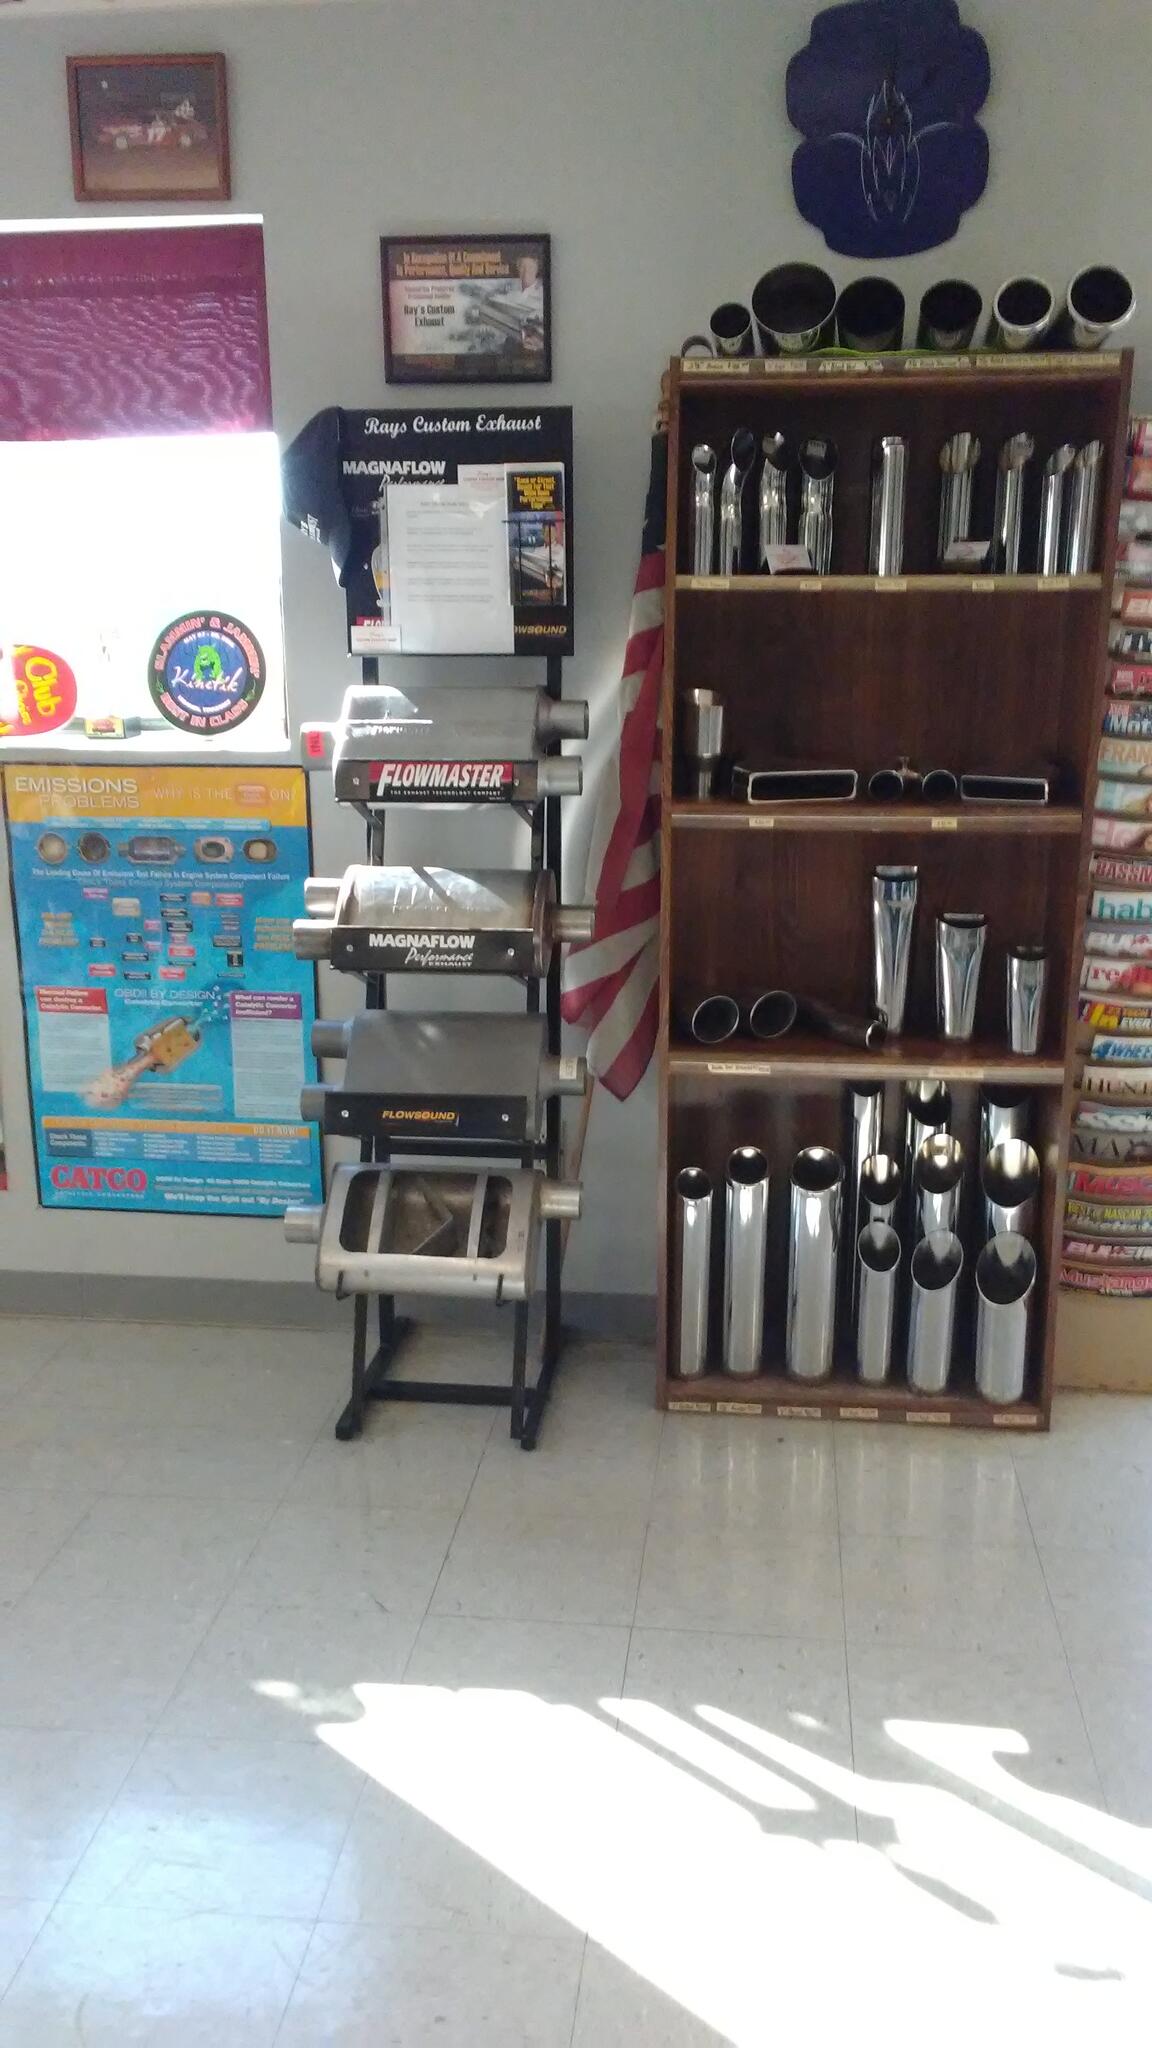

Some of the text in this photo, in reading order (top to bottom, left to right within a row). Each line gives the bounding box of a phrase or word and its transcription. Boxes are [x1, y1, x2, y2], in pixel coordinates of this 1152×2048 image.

[404, 303, 455, 316] Ray's Custom
[414, 315, 445, 327] Exhaust
[364, 414, 541, 439] Rays Custom Exhaust
[342, 460, 446, 475] MAGNAFLOW
[209, 616, 221, 629] &
[513, 625, 568, 635] OWSOUND
[24, 656, 62, 717] Club
[171, 666, 243, 692] Kinetik
[190, 715, 206, 728] IN
[15, 777, 138, 794] EMISSIONS
[376, 763, 505, 797] FLOWMASTER
[154, 787, 183, 799] WHY
[192, 788, 201, 799] IS
[208, 788, 233, 800] THE
[39, 794, 140, 809] PROBLEMS
[369, 933, 476, 949] MAGNAFLOW
[404, 947, 474, 966] Performance
[170, 990, 215, 1000] DESIGN
[382, 1110, 456, 1121] FLOWSOUND
[51, 1164, 147, 1192] CATCO
